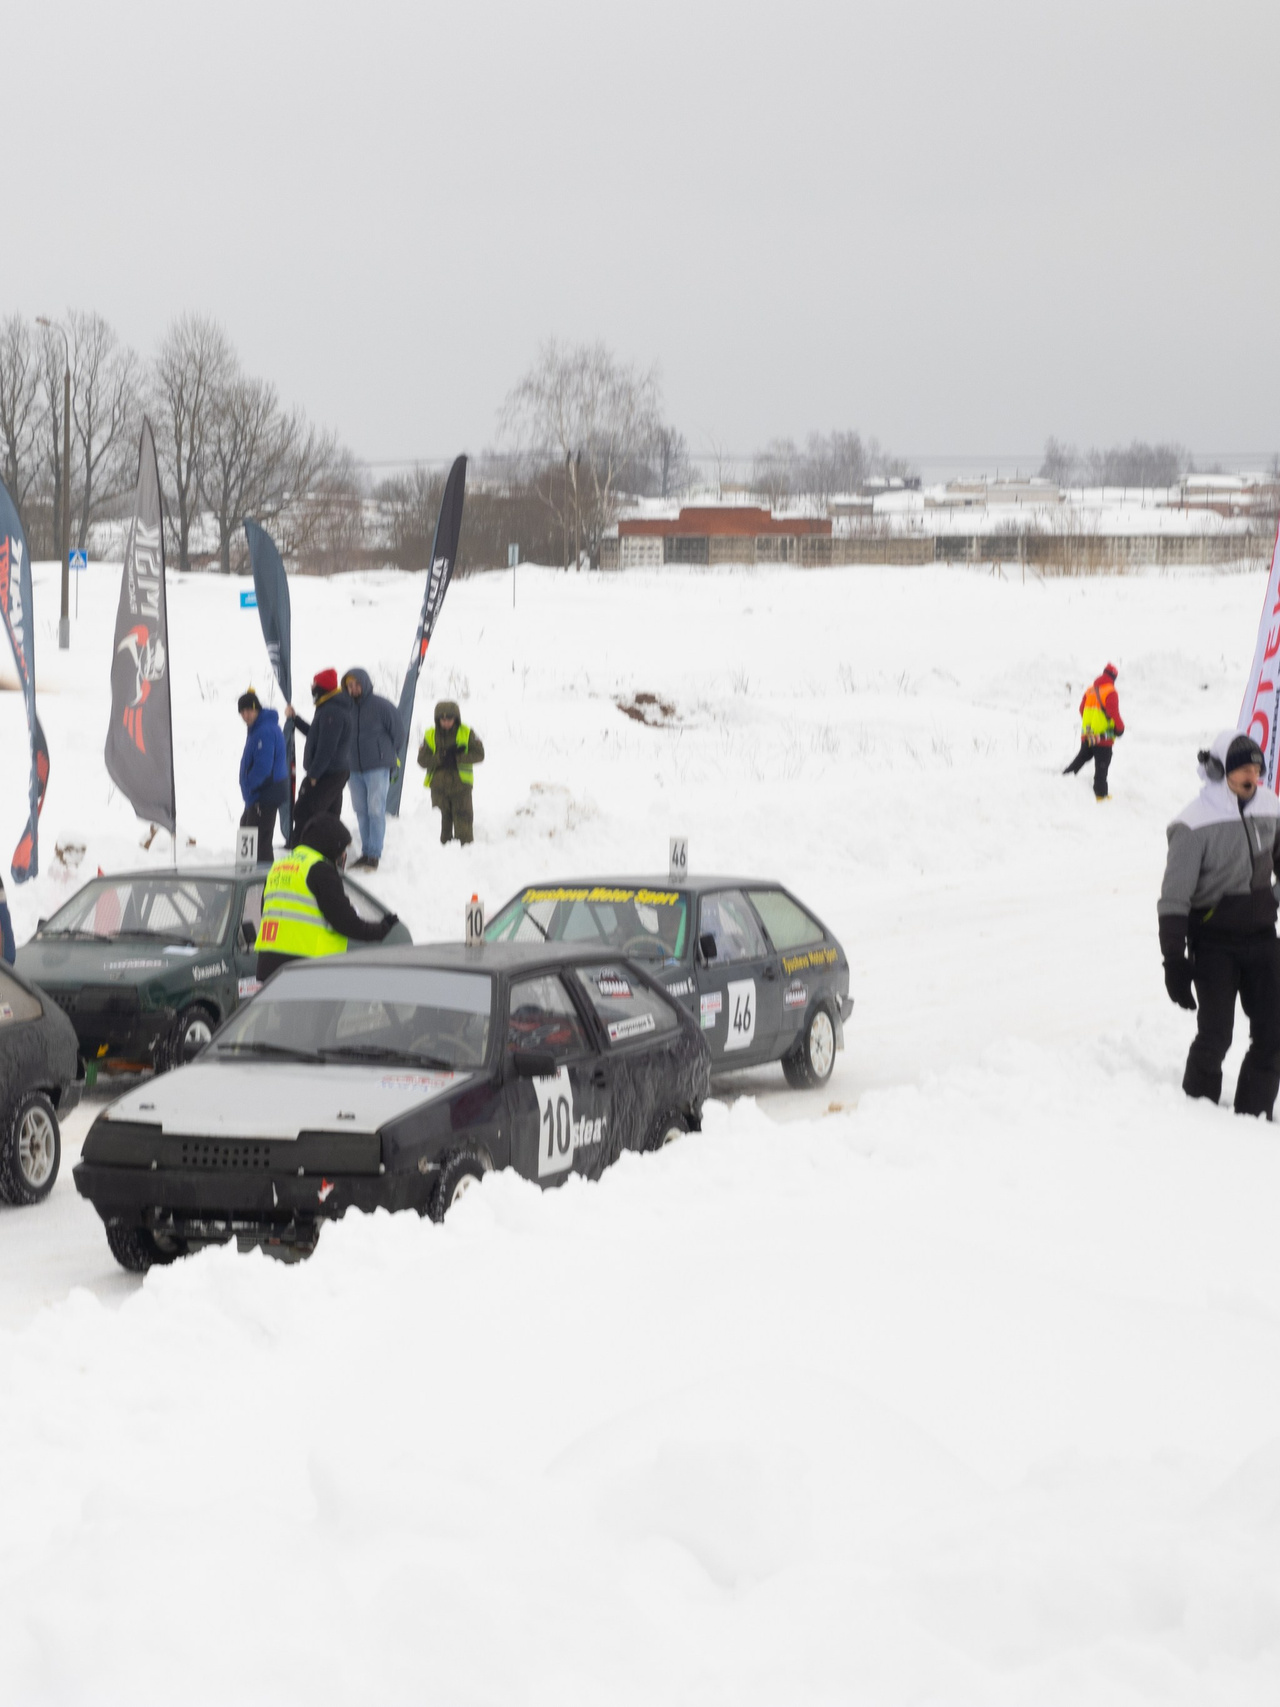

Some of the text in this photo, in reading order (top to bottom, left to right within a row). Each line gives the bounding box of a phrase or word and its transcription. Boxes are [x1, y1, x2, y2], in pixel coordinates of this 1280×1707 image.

[240, 836, 254, 858] 31
[672, 842, 686, 867] 46
[634, 888, 680, 907] Sport
[262, 921, 279, 942] 10
[468, 909, 483, 938] 10
[733, 993, 752, 1033] 46
[543, 1094, 572, 1159] 10
